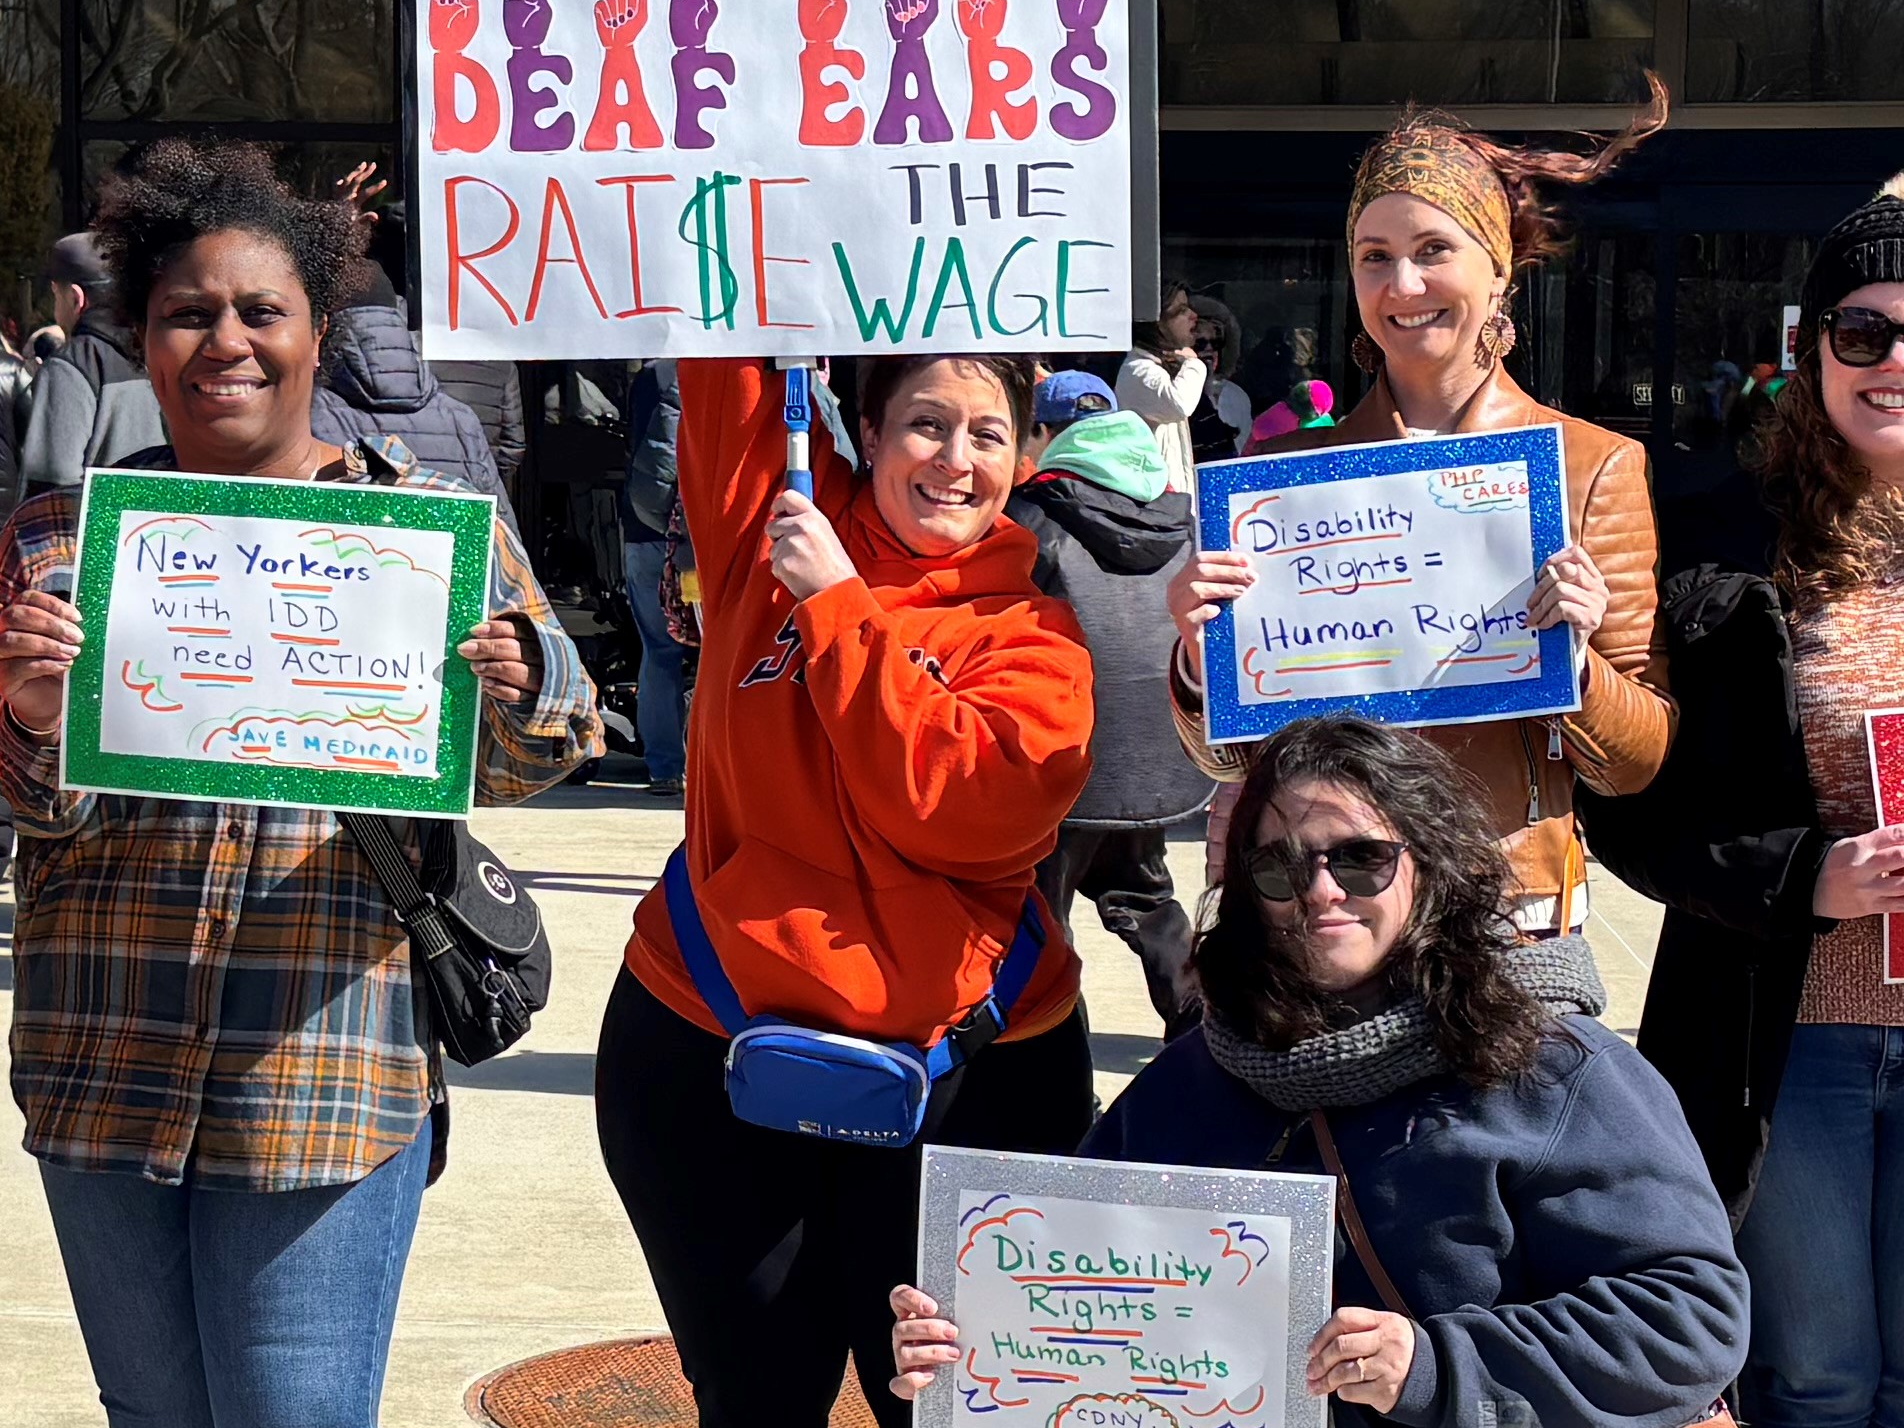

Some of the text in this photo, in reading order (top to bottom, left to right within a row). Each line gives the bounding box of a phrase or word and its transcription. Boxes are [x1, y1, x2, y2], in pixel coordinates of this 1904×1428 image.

[443, 162, 1074, 331] RAI$E THE
[833, 237, 1114, 343] WAGE
[1440, 469, 1483, 486] PHP
[1463, 481, 1529, 500] CARES
[1247, 504, 1413, 553] Disability
[137, 534, 370, 581] New Yorkers
[1289, 553, 1408, 594] Rights
[152, 597, 338, 631] with IDD
[1260, 617, 1393, 652] Human
[173, 645, 424, 690] need ACTION!
[228, 728, 427, 764] SAVE MEDICAID
[852, 1129, 900, 1138] DELTA
[992, 1235, 1212, 1286] Disability
[1021, 1283, 1157, 1333] Rights
[991, 1331, 1229, 1385] Human Rights
